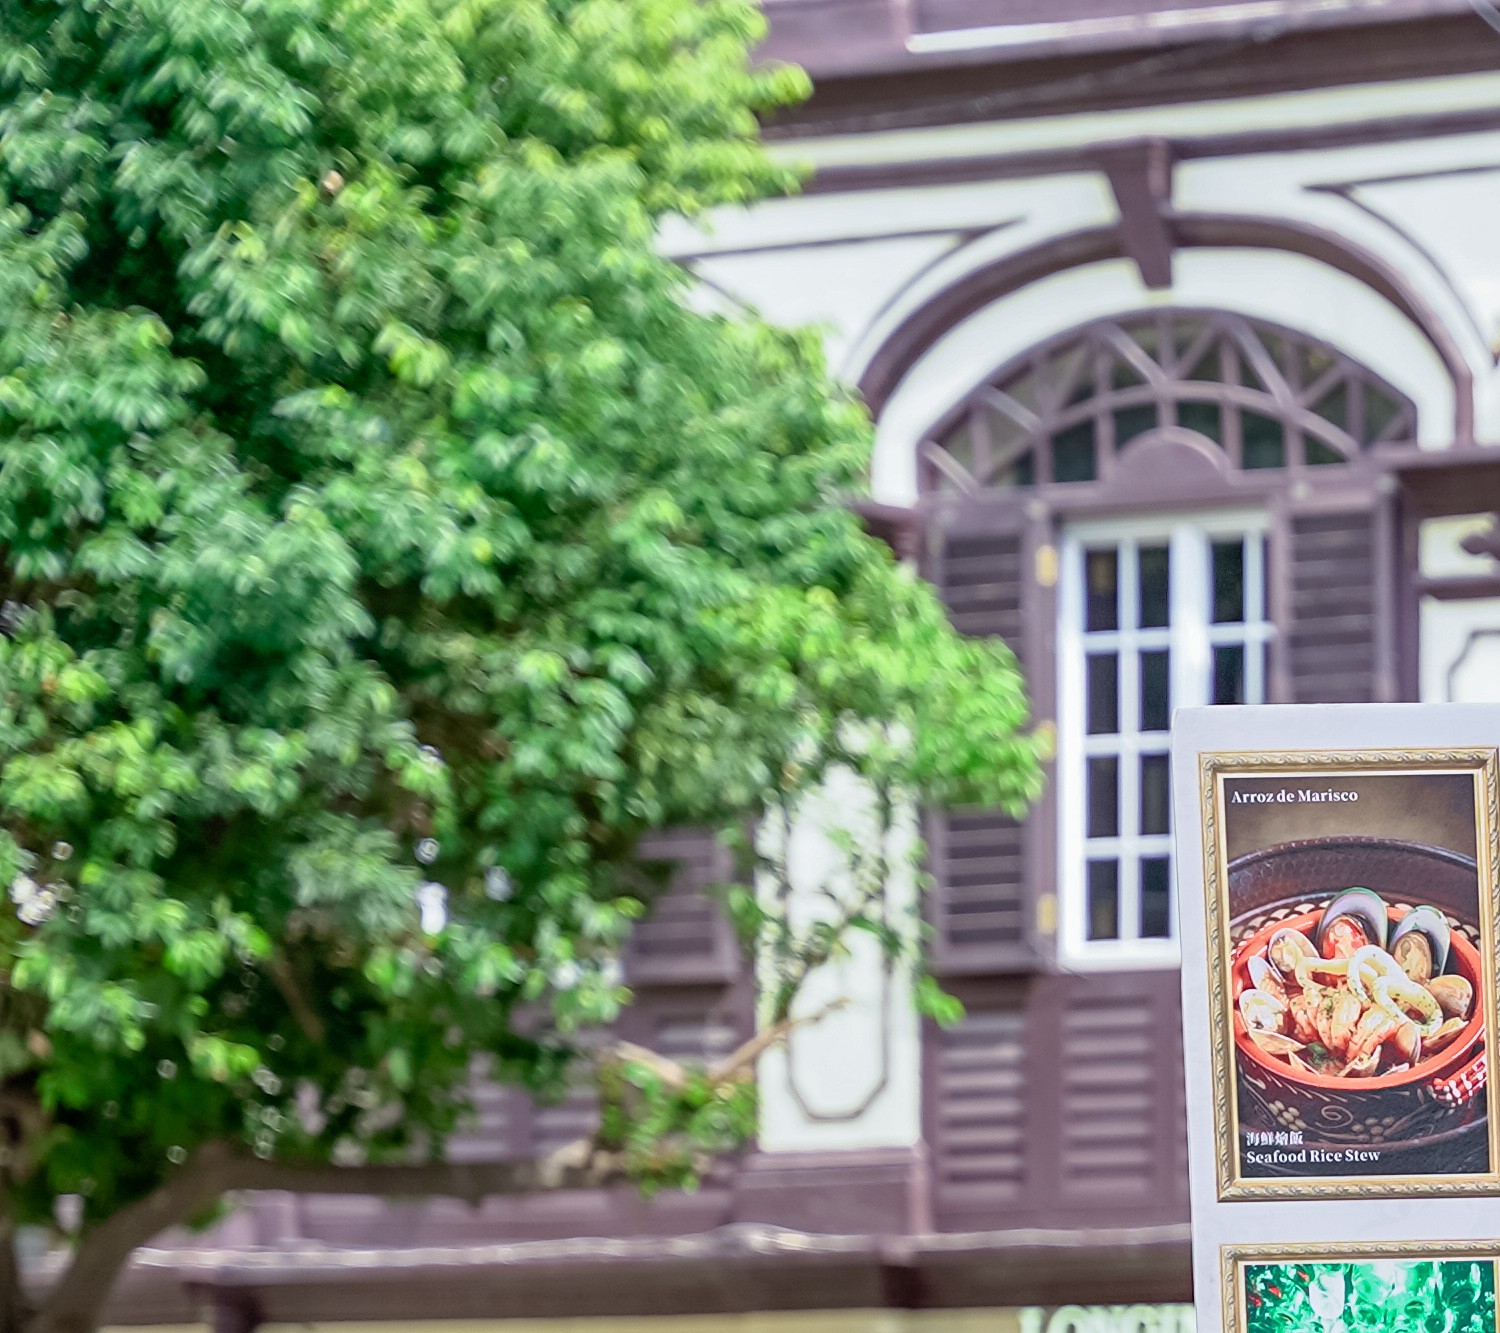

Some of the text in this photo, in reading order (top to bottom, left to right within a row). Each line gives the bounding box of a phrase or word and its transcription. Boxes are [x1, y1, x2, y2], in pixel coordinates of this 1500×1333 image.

[1231, 788, 1359, 804] Arroz de Marisco
[1246, 1148, 1381, 1164] Seafood Rice Stew
